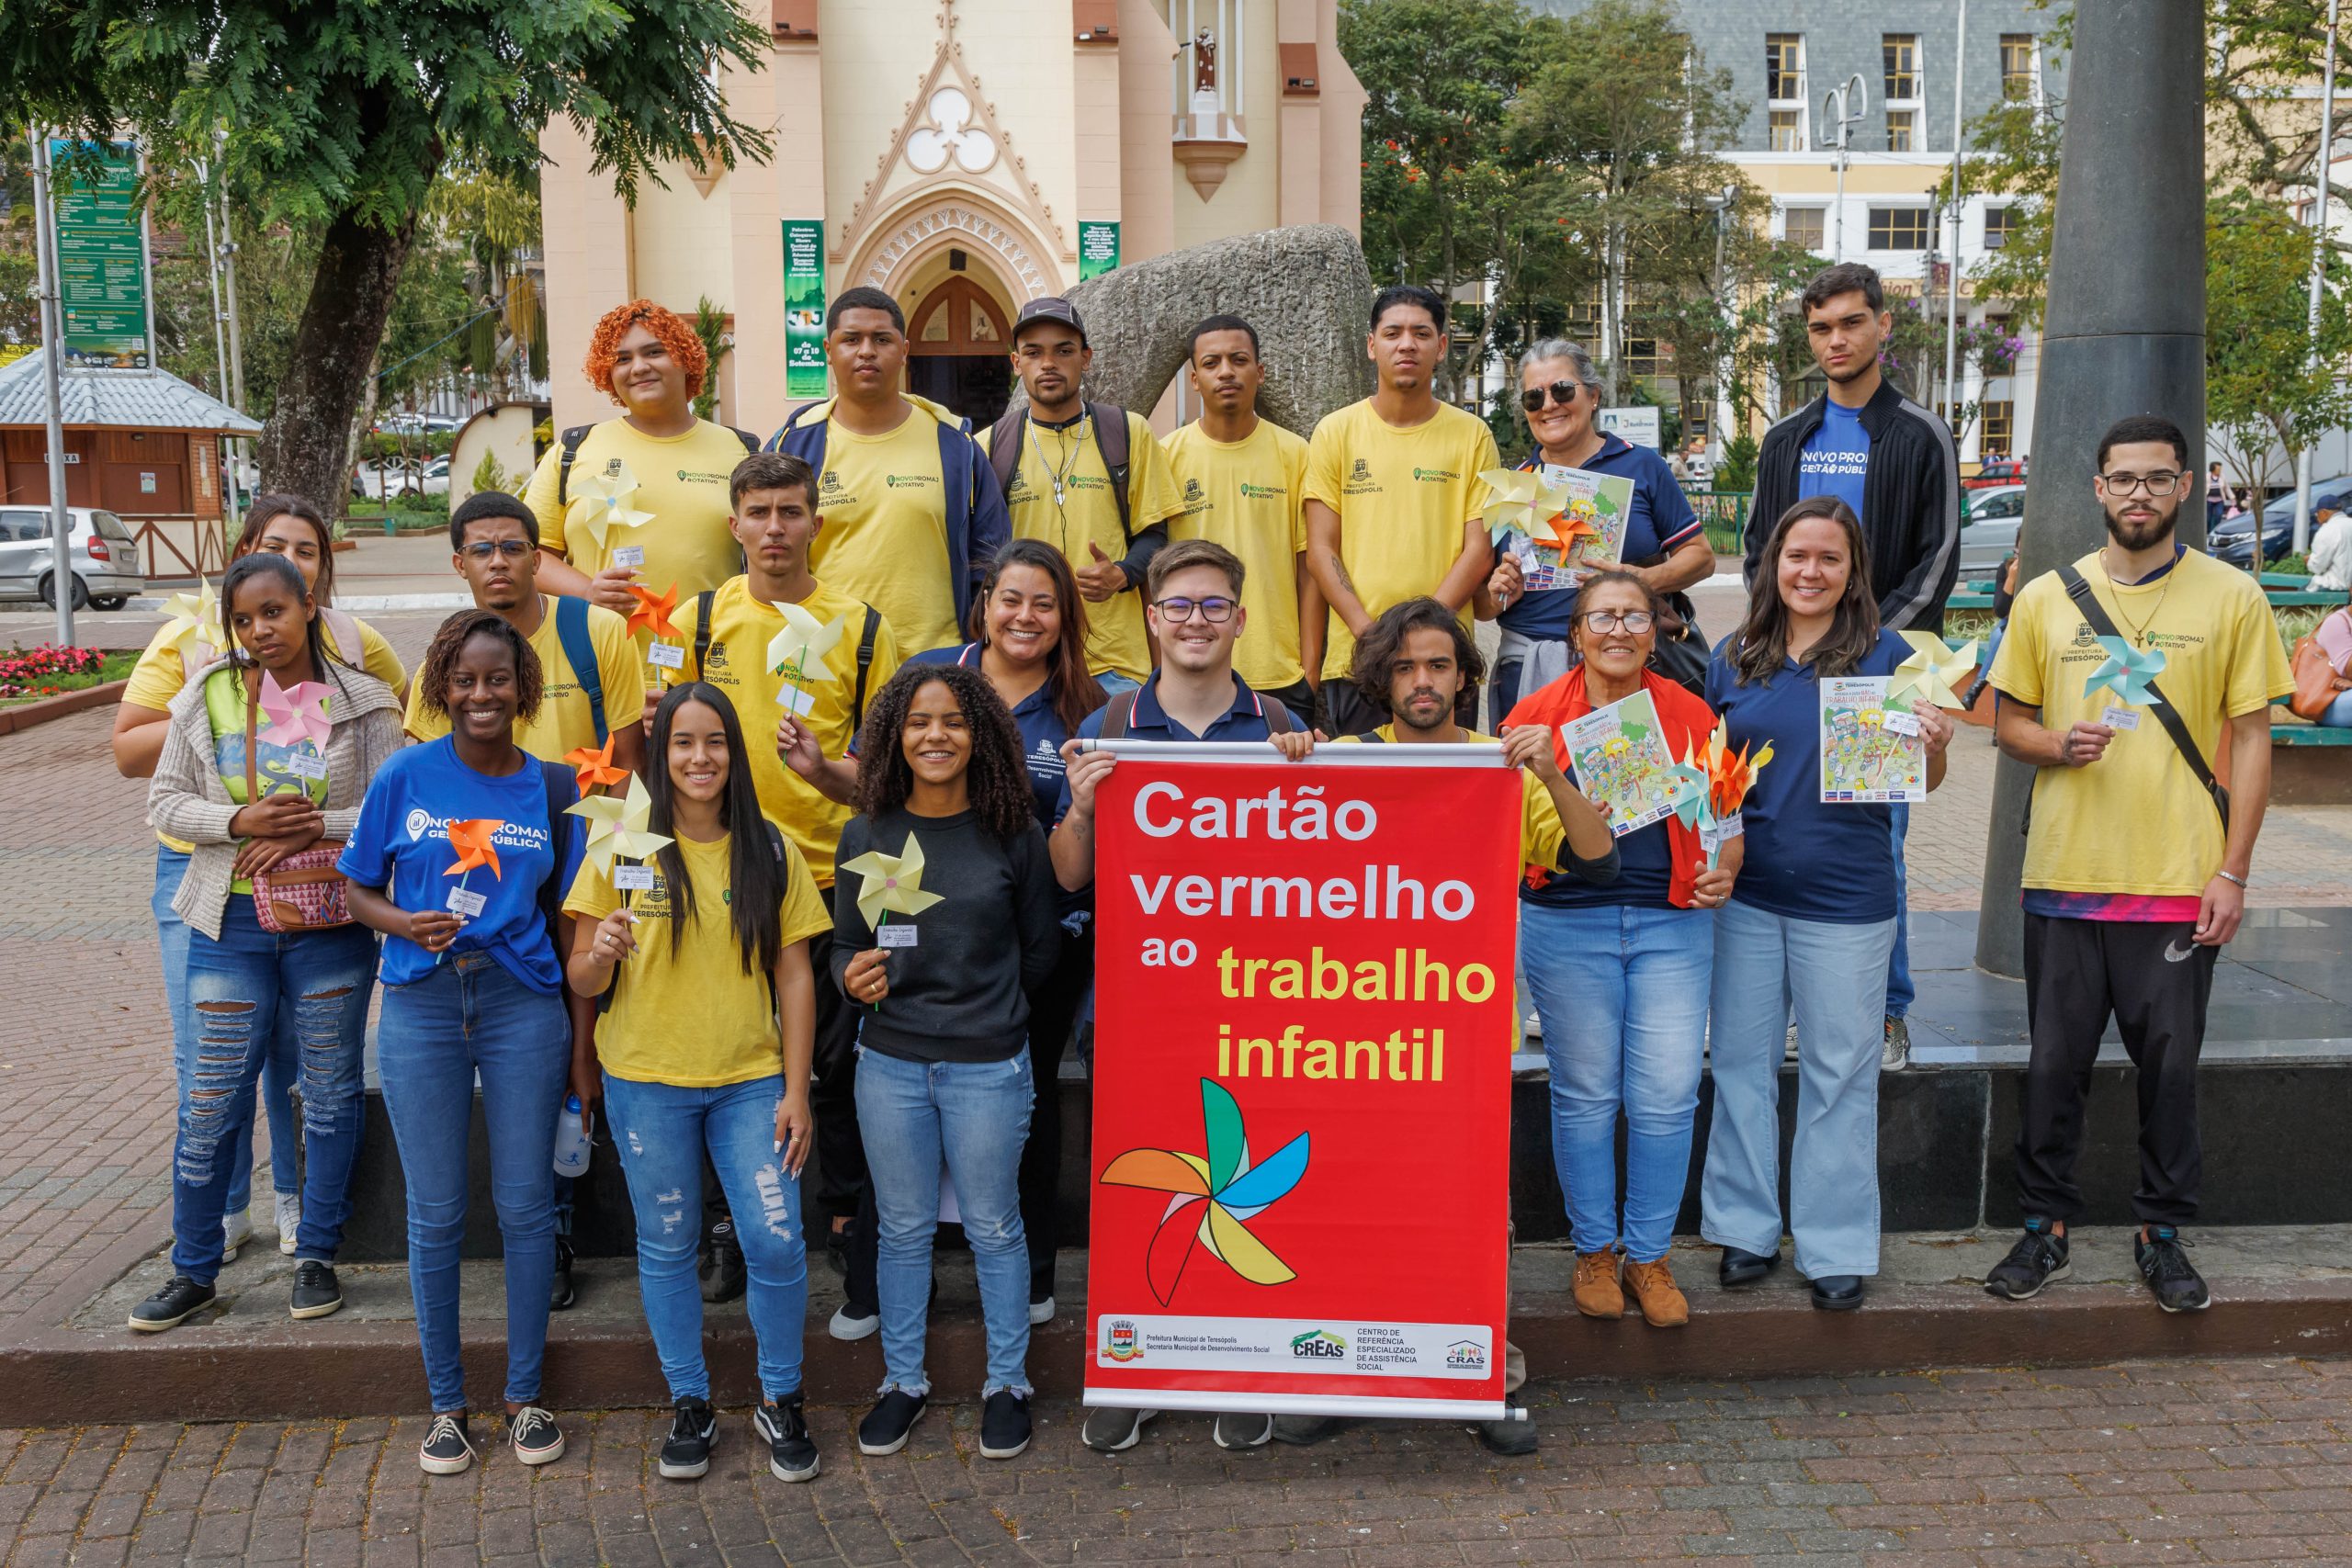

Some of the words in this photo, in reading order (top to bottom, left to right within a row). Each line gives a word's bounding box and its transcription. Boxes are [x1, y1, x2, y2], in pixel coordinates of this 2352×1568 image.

[1838, 451, 1869, 464] PRO
[1838, 463, 1866, 474] PÚBL
[818, 497, 857, 507] RESÓPOLIS
[2061, 654, 2111, 663] TERESÓPOLIS
[785, 664, 799, 673] NOV
[1026, 754, 1066, 764] TERESÓPOLIS
[1134, 781, 1378, 841] Cartão
[429, 817, 468, 828] NOV
[497, 823, 548, 842] ROMAJ
[428, 829, 449, 839] GES
[488, 831, 542, 851] PÚBLICA
[1129, 865, 1476, 921] vermelho
[1140, 938, 1198, 968] ao
[1216, 946, 1497, 1004] trabalho
[1217, 1024, 1445, 1082] infantil
[1173, 1335, 1198, 1343] Municipal
[1357, 1336, 1404, 1345] REFERÊNCIA
[1294, 1340, 1344, 1357] CREAS
[1357, 1346, 1416, 1354] ESPECIALIZADO
[1368, 1355, 1417, 1363] ASSISTÊNCIA
